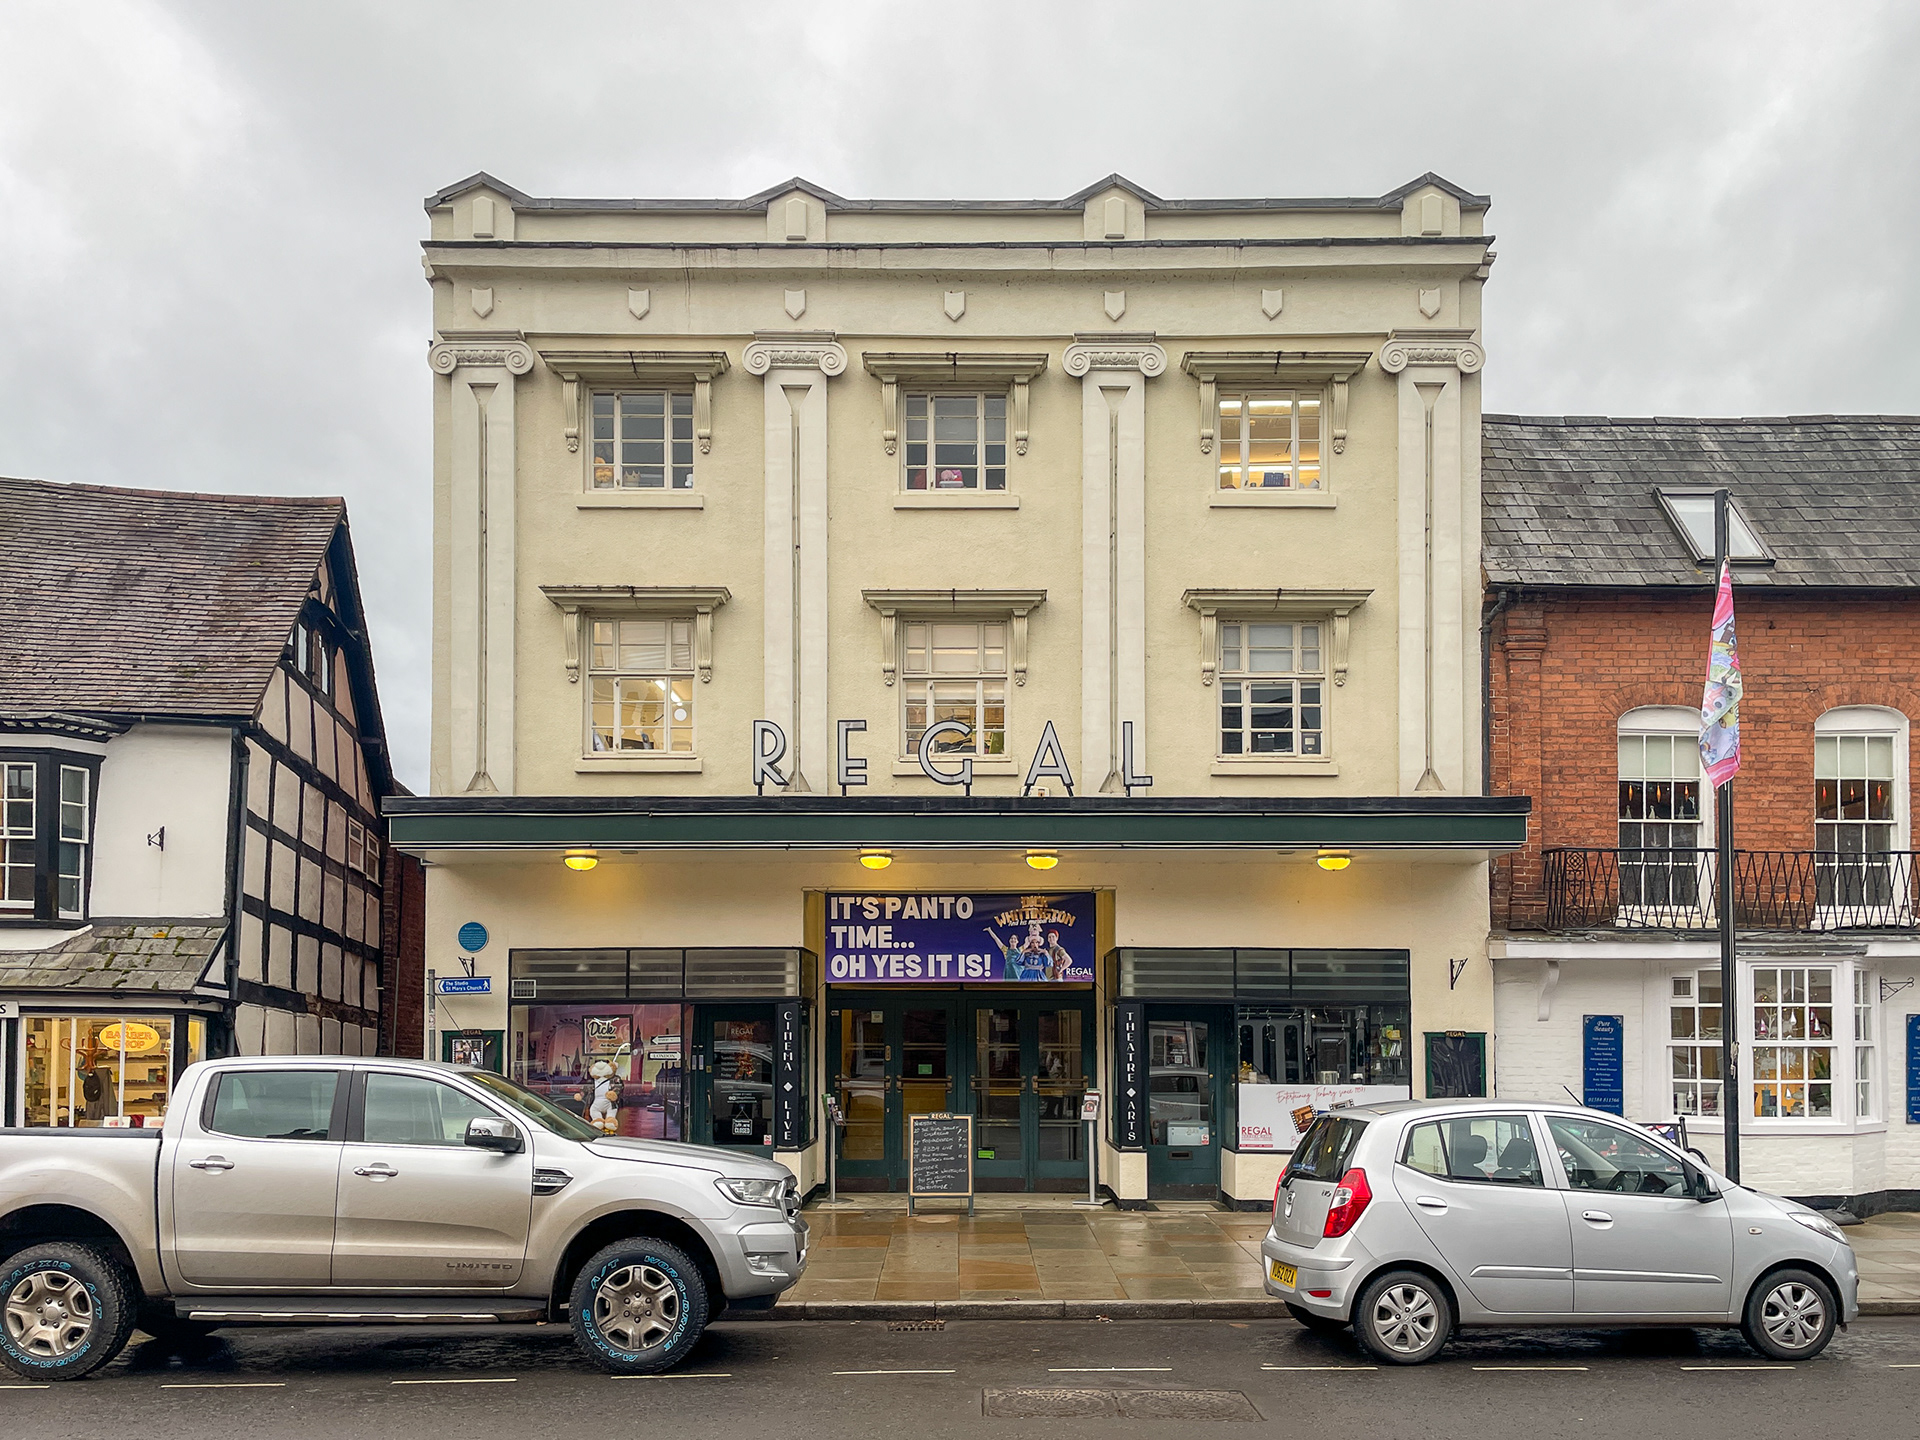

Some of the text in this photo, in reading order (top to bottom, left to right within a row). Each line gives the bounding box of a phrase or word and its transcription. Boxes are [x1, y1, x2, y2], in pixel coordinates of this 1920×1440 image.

[752, 719, 1153, 786] REGAL
[830, 896, 974, 920] IT'S PANTO
[994, 908, 1076, 927] WHITTINGTON
[830, 925, 915, 949] TIME...
[830, 953, 991, 978] OH YES IT IS!
[1066, 967, 1093, 976] REGAL
[588, 1020, 617, 1037] Dick
[730, 1027, 754, 1035] REGAL
[1593, 1026, 1614, 1034] Beauty
[783, 1011, 793, 1141] CINEMA LIVE
[1125, 1011, 1136, 1141] THEATRE ARTS
[1276, 1089, 1312, 1104] Entertaining
[1312, 1086, 1338, 1102] Tenbury
[1338, 1088, 1354, 1098] since
[1241, 1126, 1273, 1136] REGAL
[0, 1260, 72, 1296] MAXXIS
[446, 1262, 512, 1270] LIMITED
[85, 1282, 103, 1319] A/T
[643, 1255, 690, 1352] WORM-DRIVE
[582, 1308, 639, 1362] MAXXIS
